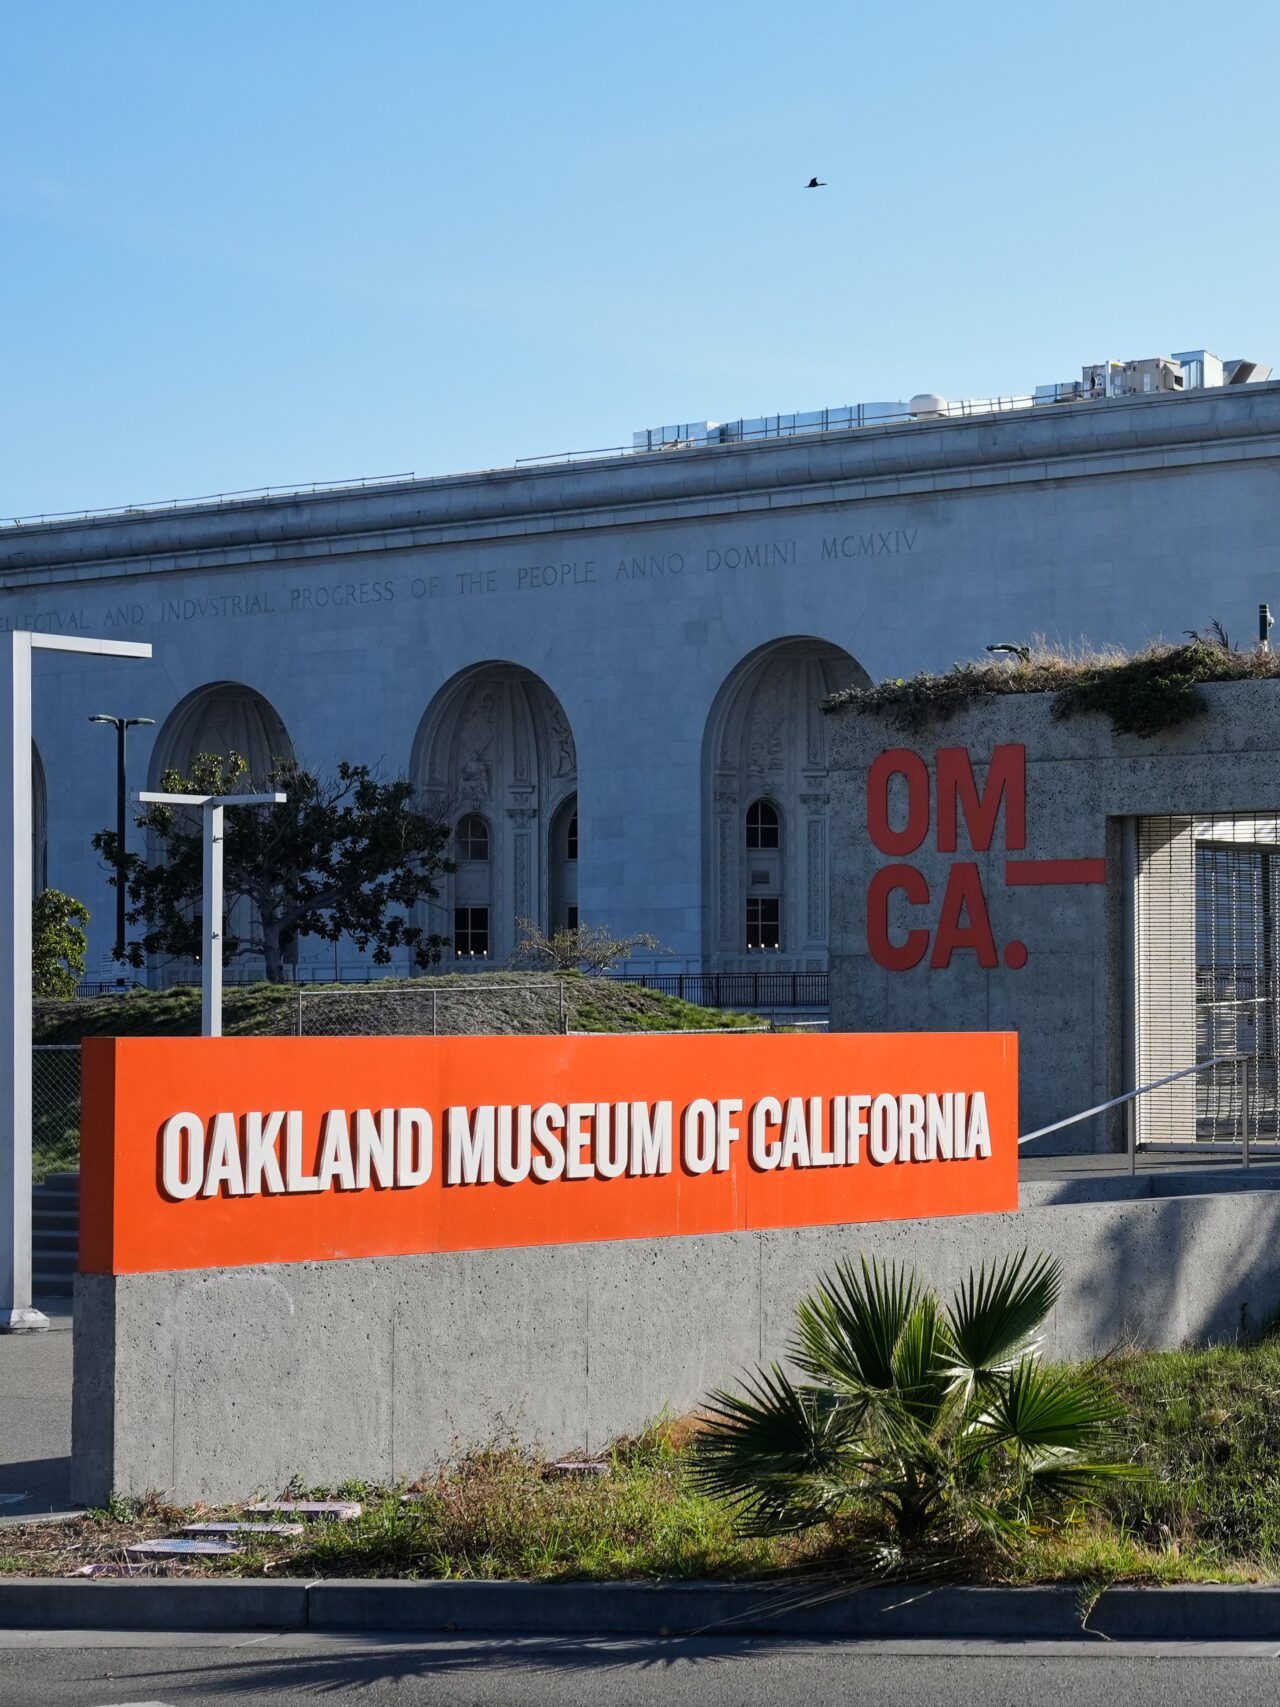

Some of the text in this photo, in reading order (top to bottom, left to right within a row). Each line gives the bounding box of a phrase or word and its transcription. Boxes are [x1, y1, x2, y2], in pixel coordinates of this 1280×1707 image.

[103, 604, 144, 627] AND
[161, 592, 275, 622] INDVSTRIAL
[290, 580, 394, 610] PROGRESS
[411, 576, 440, 599] OF
[456, 570, 498, 595] THE
[518, 561, 596, 590] PEOPLE
[615, 552, 684, 580] ANNO
[706, 541, 797, 572] DOMINI
[821, 528, 918, 561] MCMXIV
[867, 743, 1026, 856] OM
[161, 1091, 992, 1200] OAKLAND MUSEUM OF CALIFORNIA
